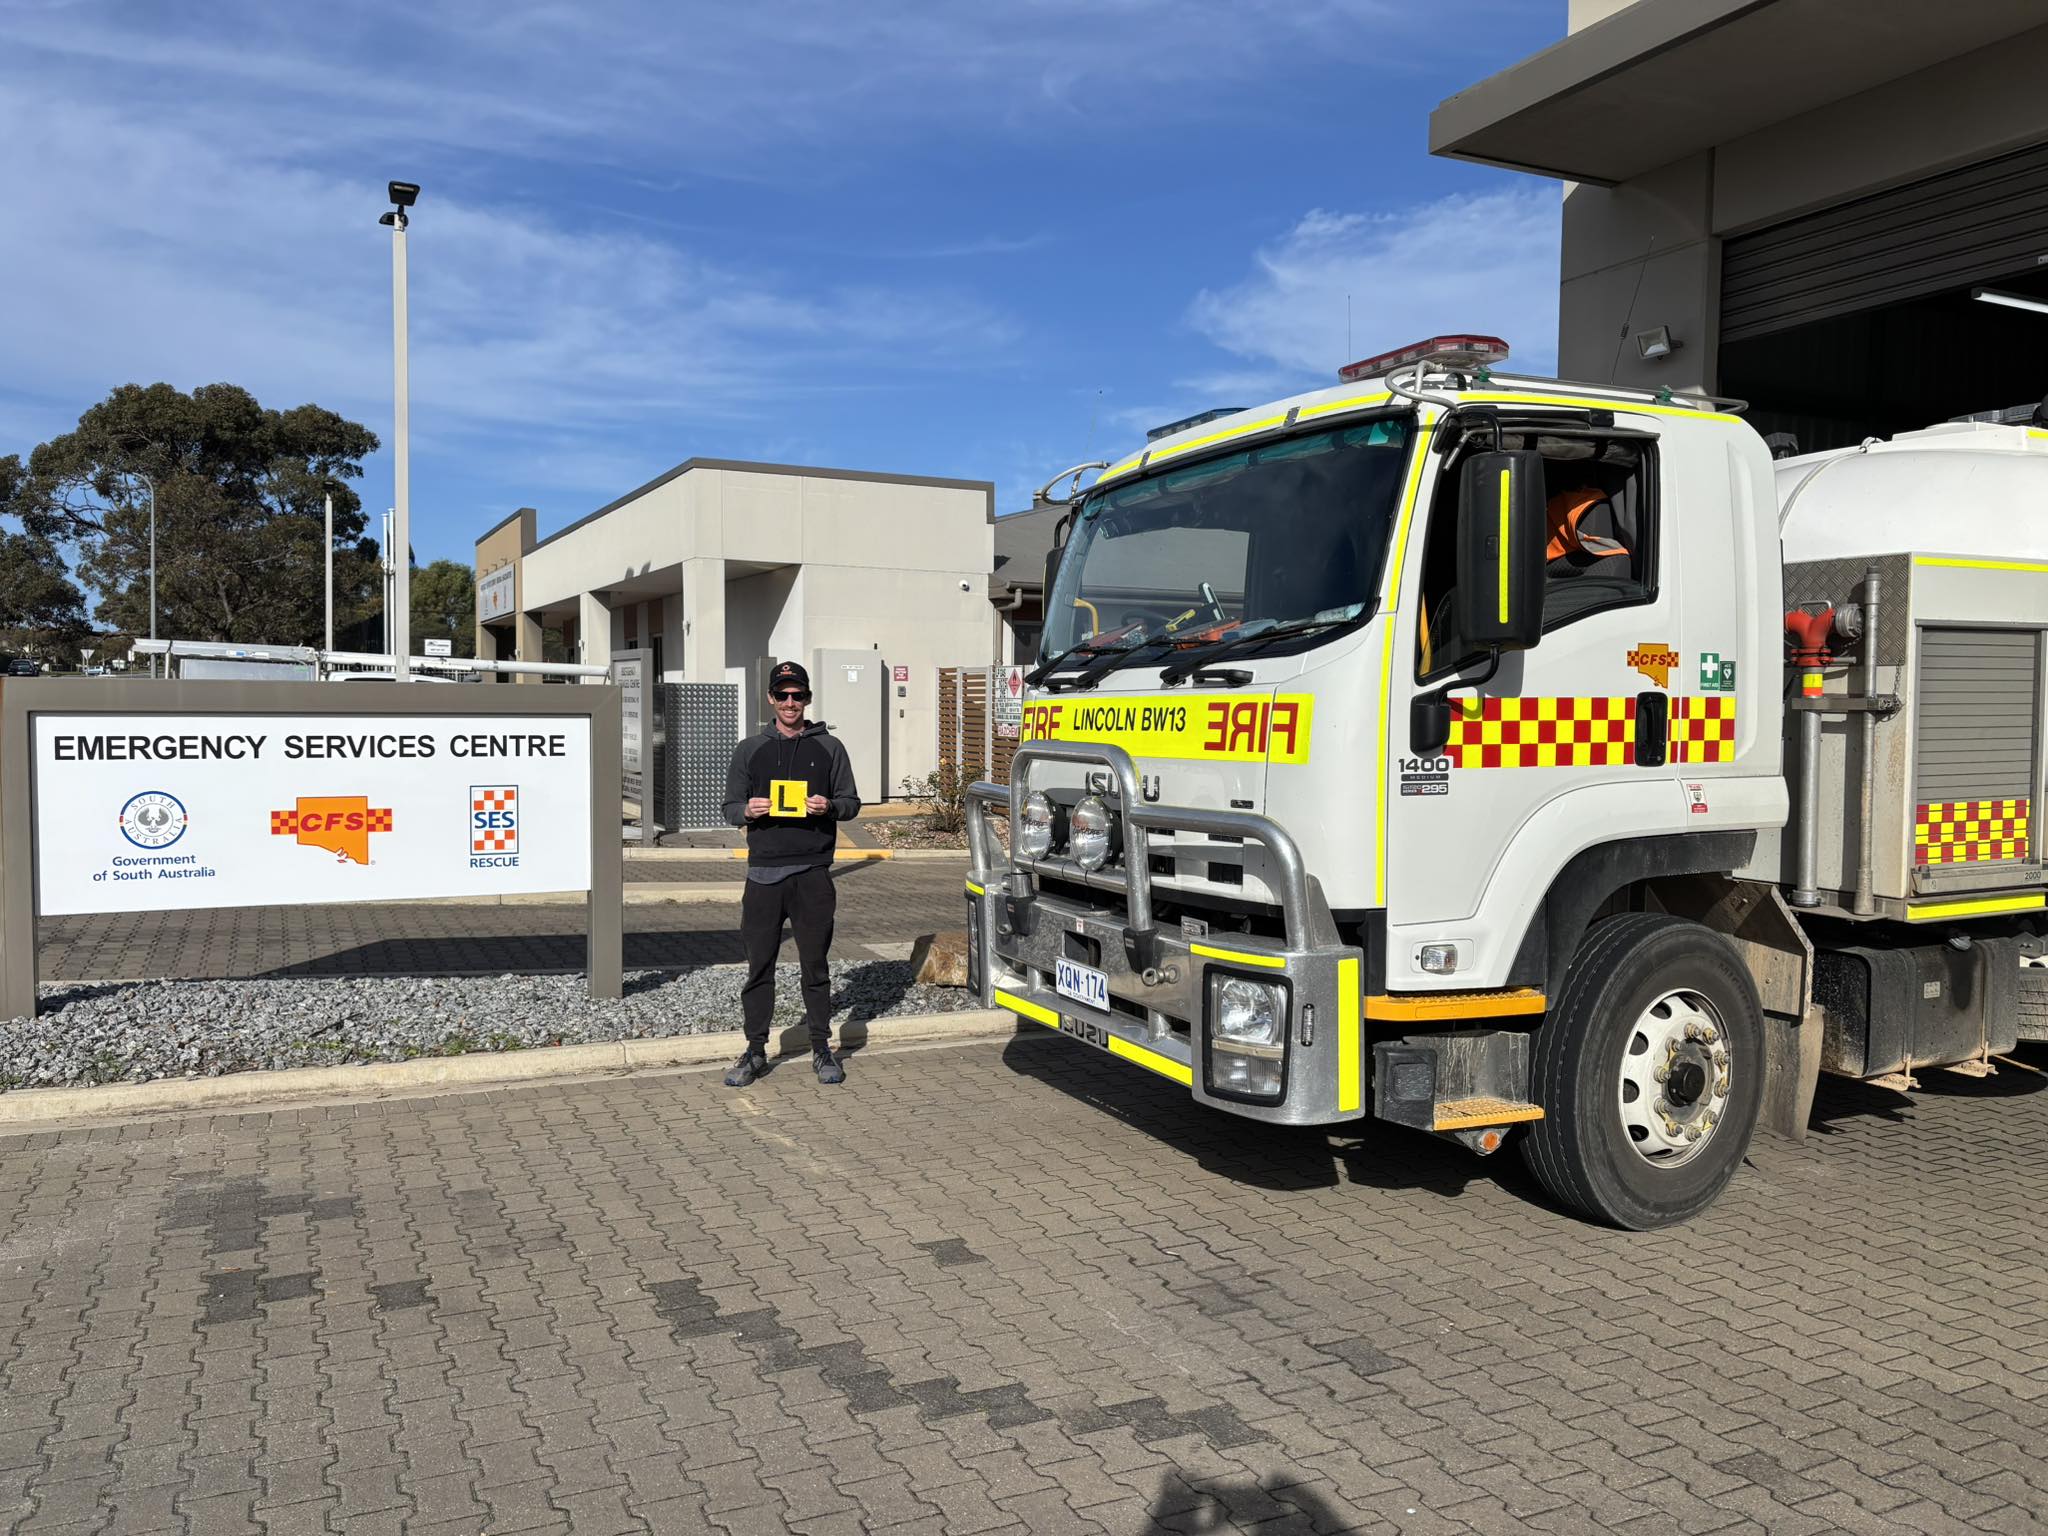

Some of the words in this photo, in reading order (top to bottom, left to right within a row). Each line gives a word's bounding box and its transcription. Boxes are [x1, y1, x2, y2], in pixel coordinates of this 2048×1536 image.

[1640, 654, 1667, 665] CFS
[1022, 705, 1063, 741] FIRE
[1073, 708, 1136, 731] LINCOLN
[1141, 707, 1186, 732] BW13
[54, 735, 267, 760] EMERGENCY
[284, 734, 435, 758] SERVICES
[450, 734, 566, 757] CENTRE
[1398, 758, 1449, 772] 1400
[1422, 784, 1447, 793] 295
[131, 796, 175, 810] SOUTH
[778, 785, 798, 812] L
[300, 812, 364, 832] CFS
[474, 811, 515, 829] SES
[125, 818, 182, 845] AUSTRALIA
[112, 855, 196, 866] Government
[470, 856, 519, 868] RESCUE
[92, 870, 107, 881] of
[113, 868, 152, 880] South
[158, 867, 216, 878] Australia
[2025, 871, 2041, 880] 2000
